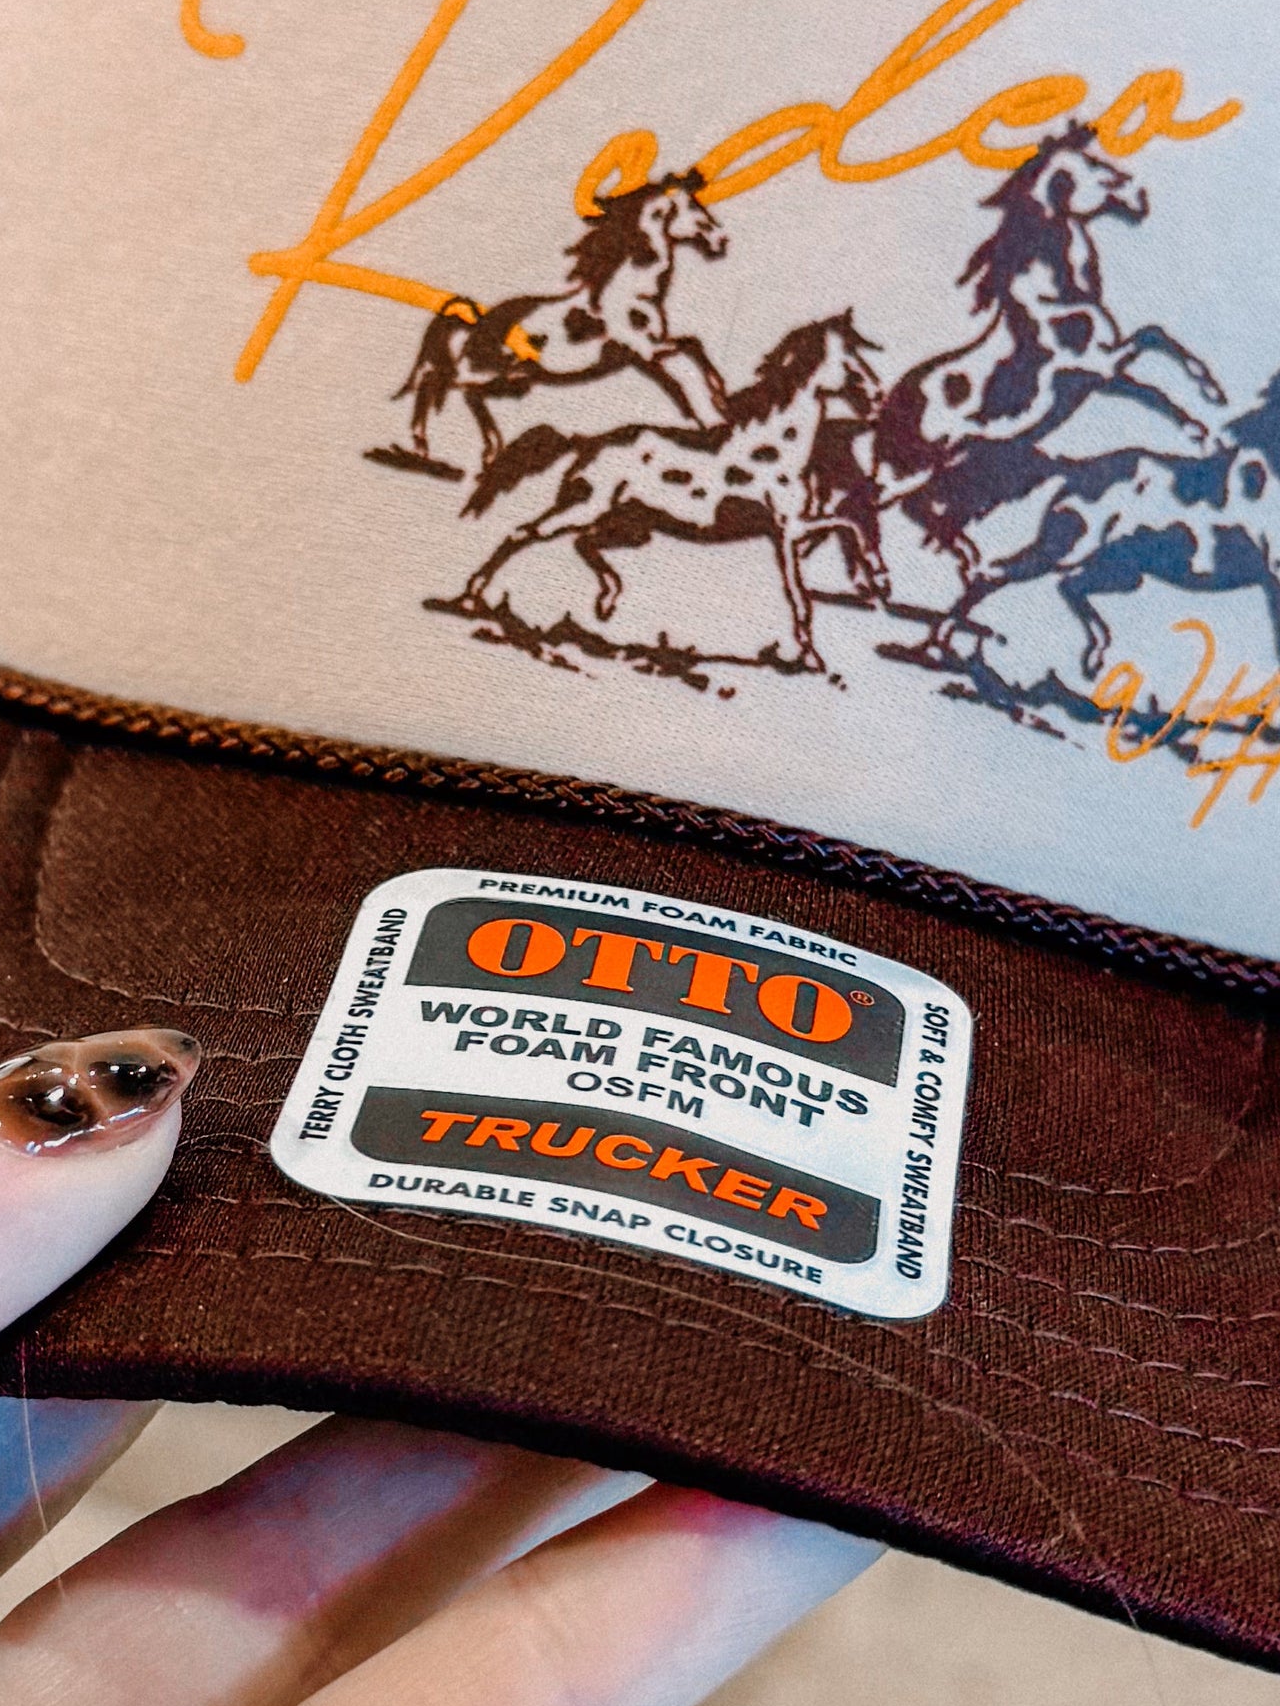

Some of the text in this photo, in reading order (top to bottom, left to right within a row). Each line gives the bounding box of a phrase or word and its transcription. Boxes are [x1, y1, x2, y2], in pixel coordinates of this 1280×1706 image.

[466, 917, 853, 1043] OTTO
[478, 878, 858, 967] PREMIUM FOAM FABRIC
[299, 907, 408, 1140] TERRY CLOTH SWEATBAND
[420, 1000, 869, 1116] WORLD FAMOUS
[454, 1030, 825, 1128] FOAM FRONT
[566, 1071, 705, 1119] OSFM
[895, 1001, 949, 1281] SOFT & COMFY SWEATBAND
[420, 1109, 828, 1232] TRUCKER
[368, 1173, 823, 1285] DURABLE SNAP CLOSURE
